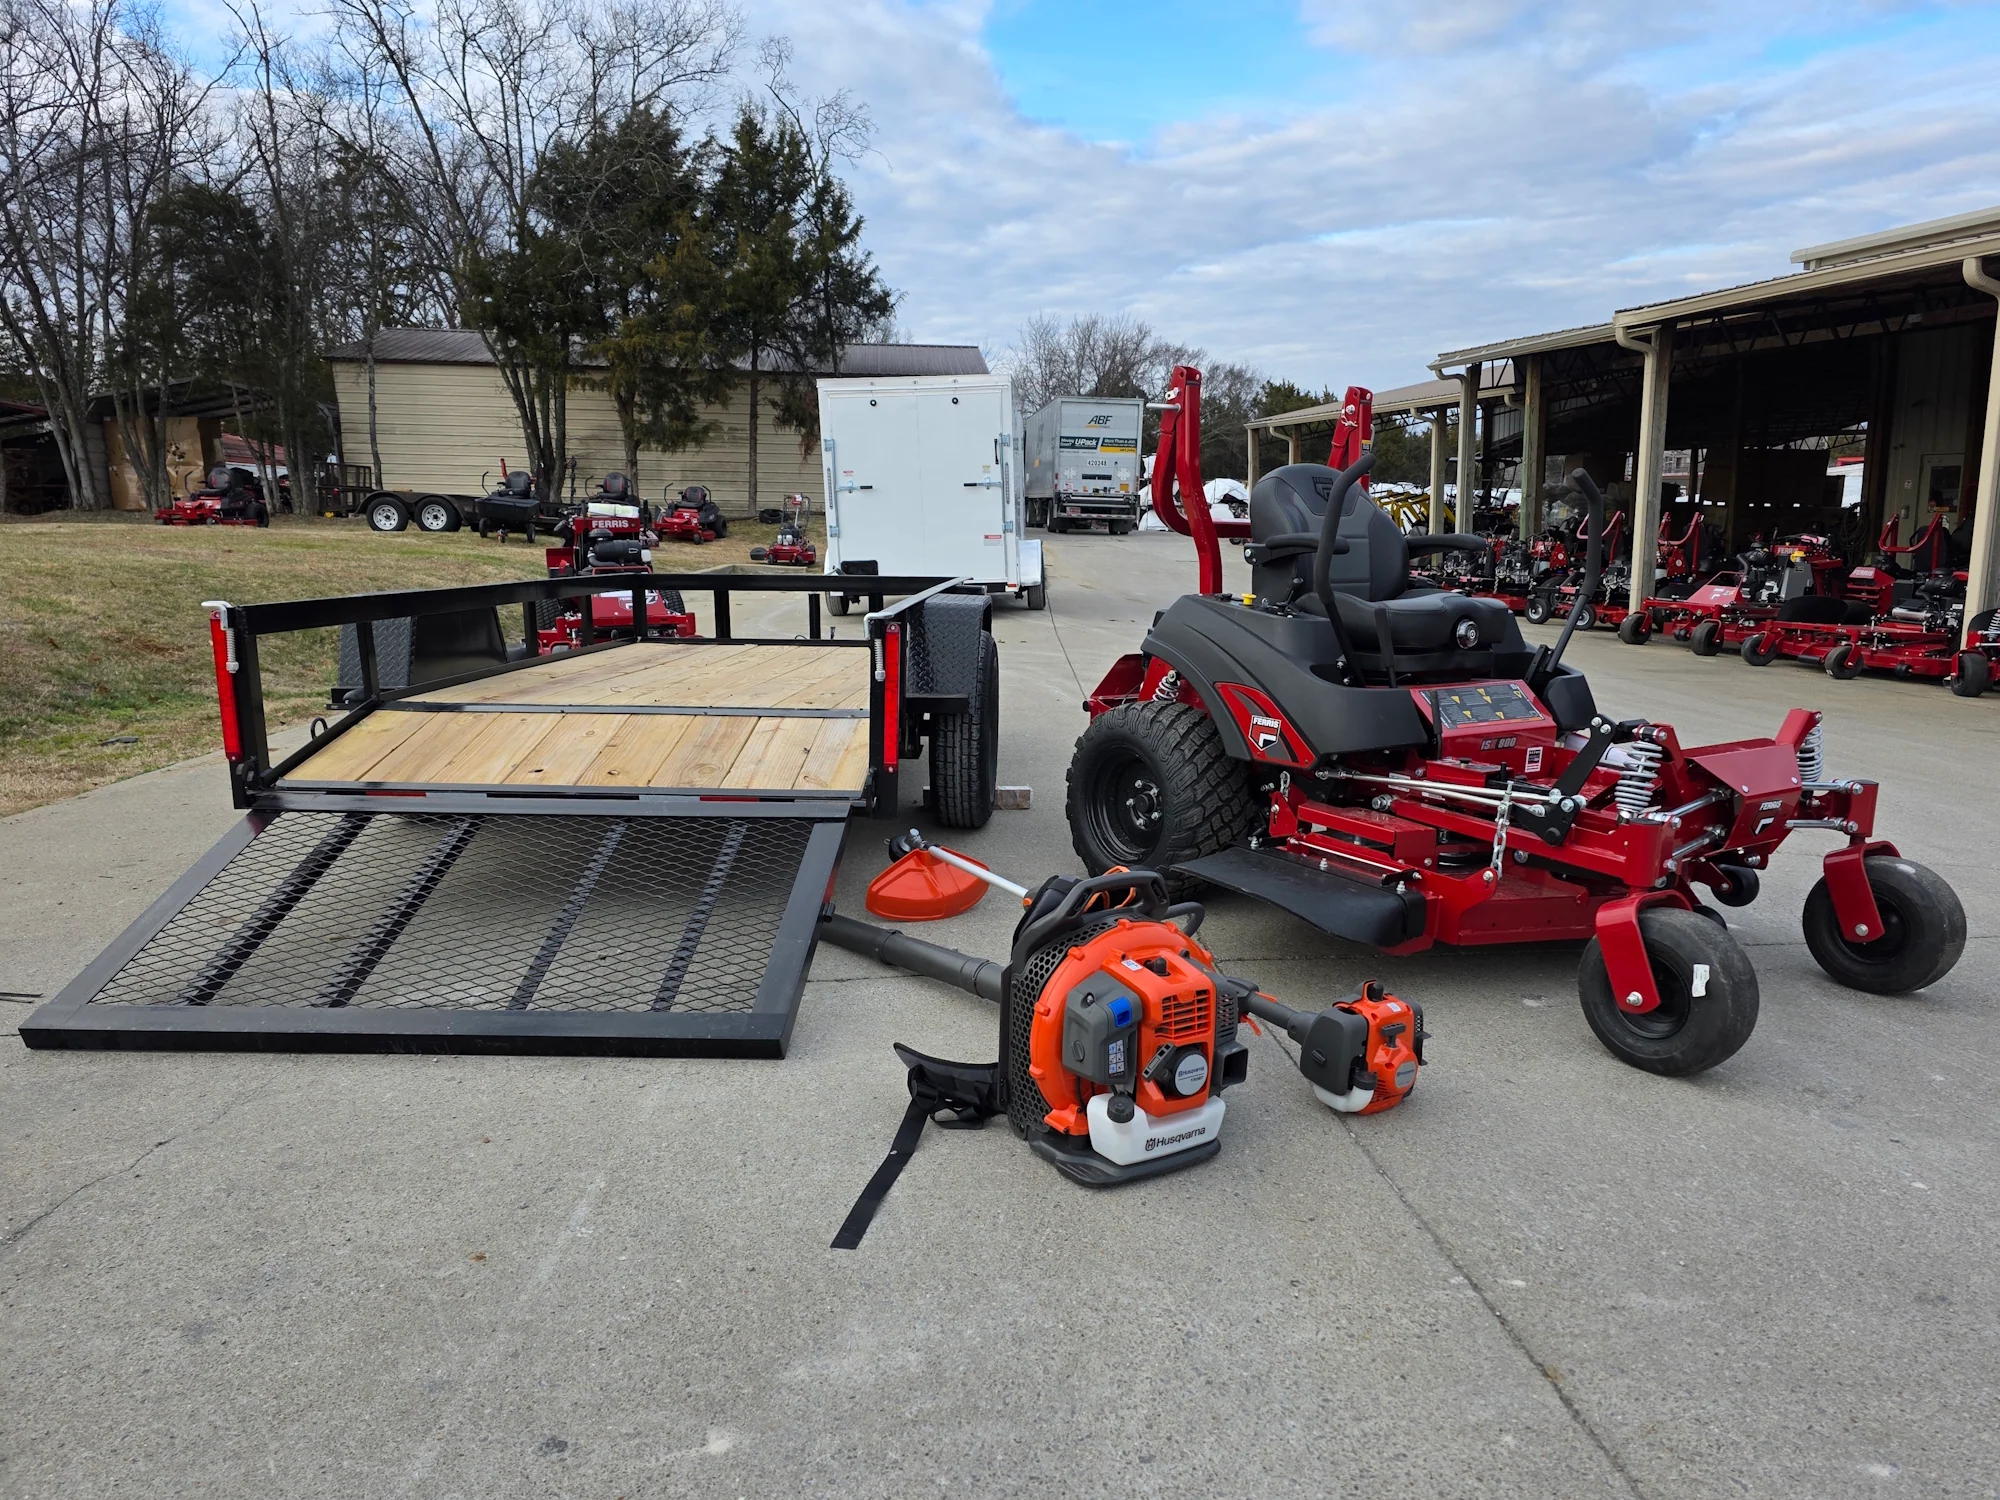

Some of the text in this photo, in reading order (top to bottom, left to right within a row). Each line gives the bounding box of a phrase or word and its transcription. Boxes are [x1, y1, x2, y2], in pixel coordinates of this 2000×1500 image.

[1088, 415, 1113, 424] ABF
[592, 520, 628, 528] FERRIS
[1253, 717, 1279, 728] FERRIS
[1498, 737, 1516, 748] 800
[1759, 800, 1782, 811] FERRIS
[1156, 1127, 1206, 1147] Husqvarna
